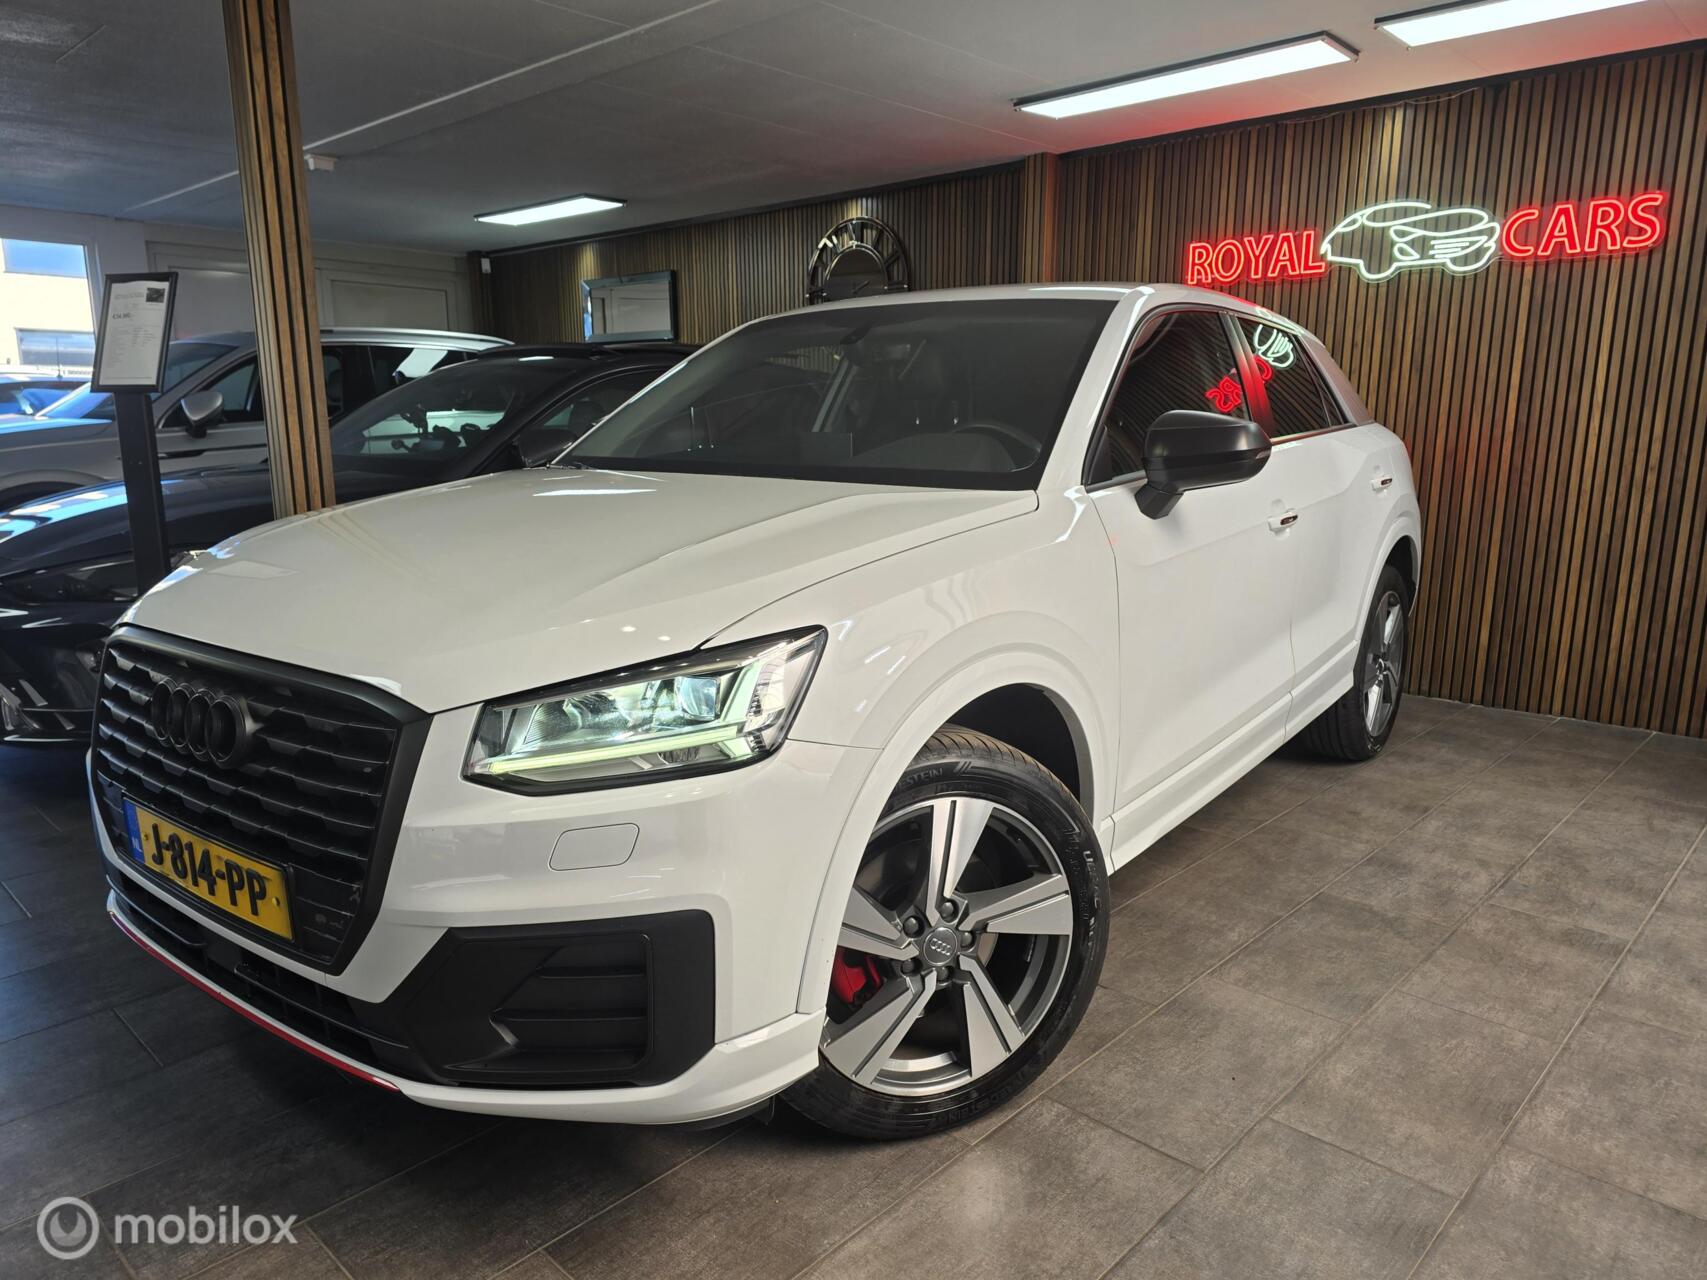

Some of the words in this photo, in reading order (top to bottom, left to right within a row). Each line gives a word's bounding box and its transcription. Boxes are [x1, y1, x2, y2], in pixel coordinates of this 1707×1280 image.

[1187, 230, 1325, 285] ROYAL
[1503, 193, 1664, 257] CARS
[151, 823, 267, 916] J-814-PP
